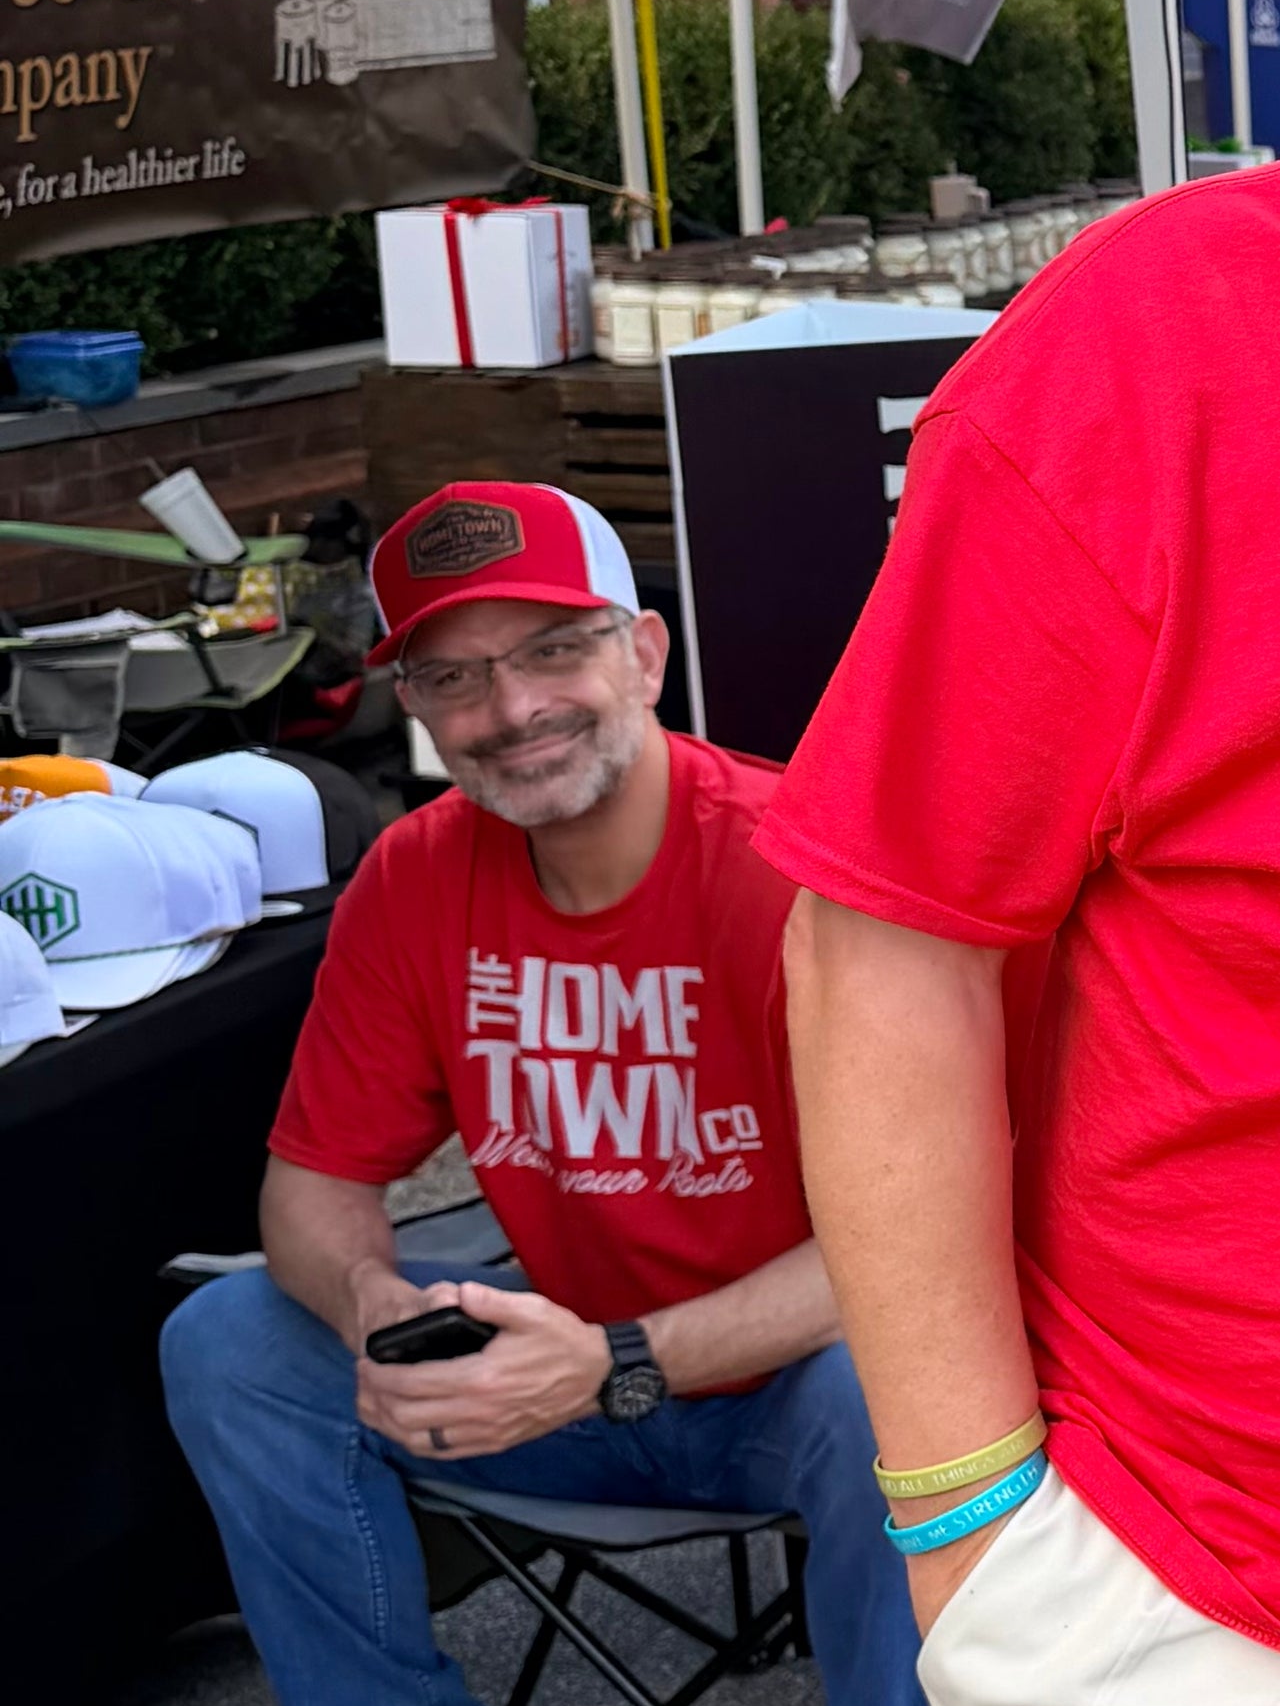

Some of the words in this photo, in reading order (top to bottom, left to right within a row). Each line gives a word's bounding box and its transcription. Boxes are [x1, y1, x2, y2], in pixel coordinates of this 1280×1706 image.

[59, 171, 78, 199] a
[81, 146, 201, 195] healthier
[202, 135, 246, 179] life
[699, 1104, 763, 1154] CO
